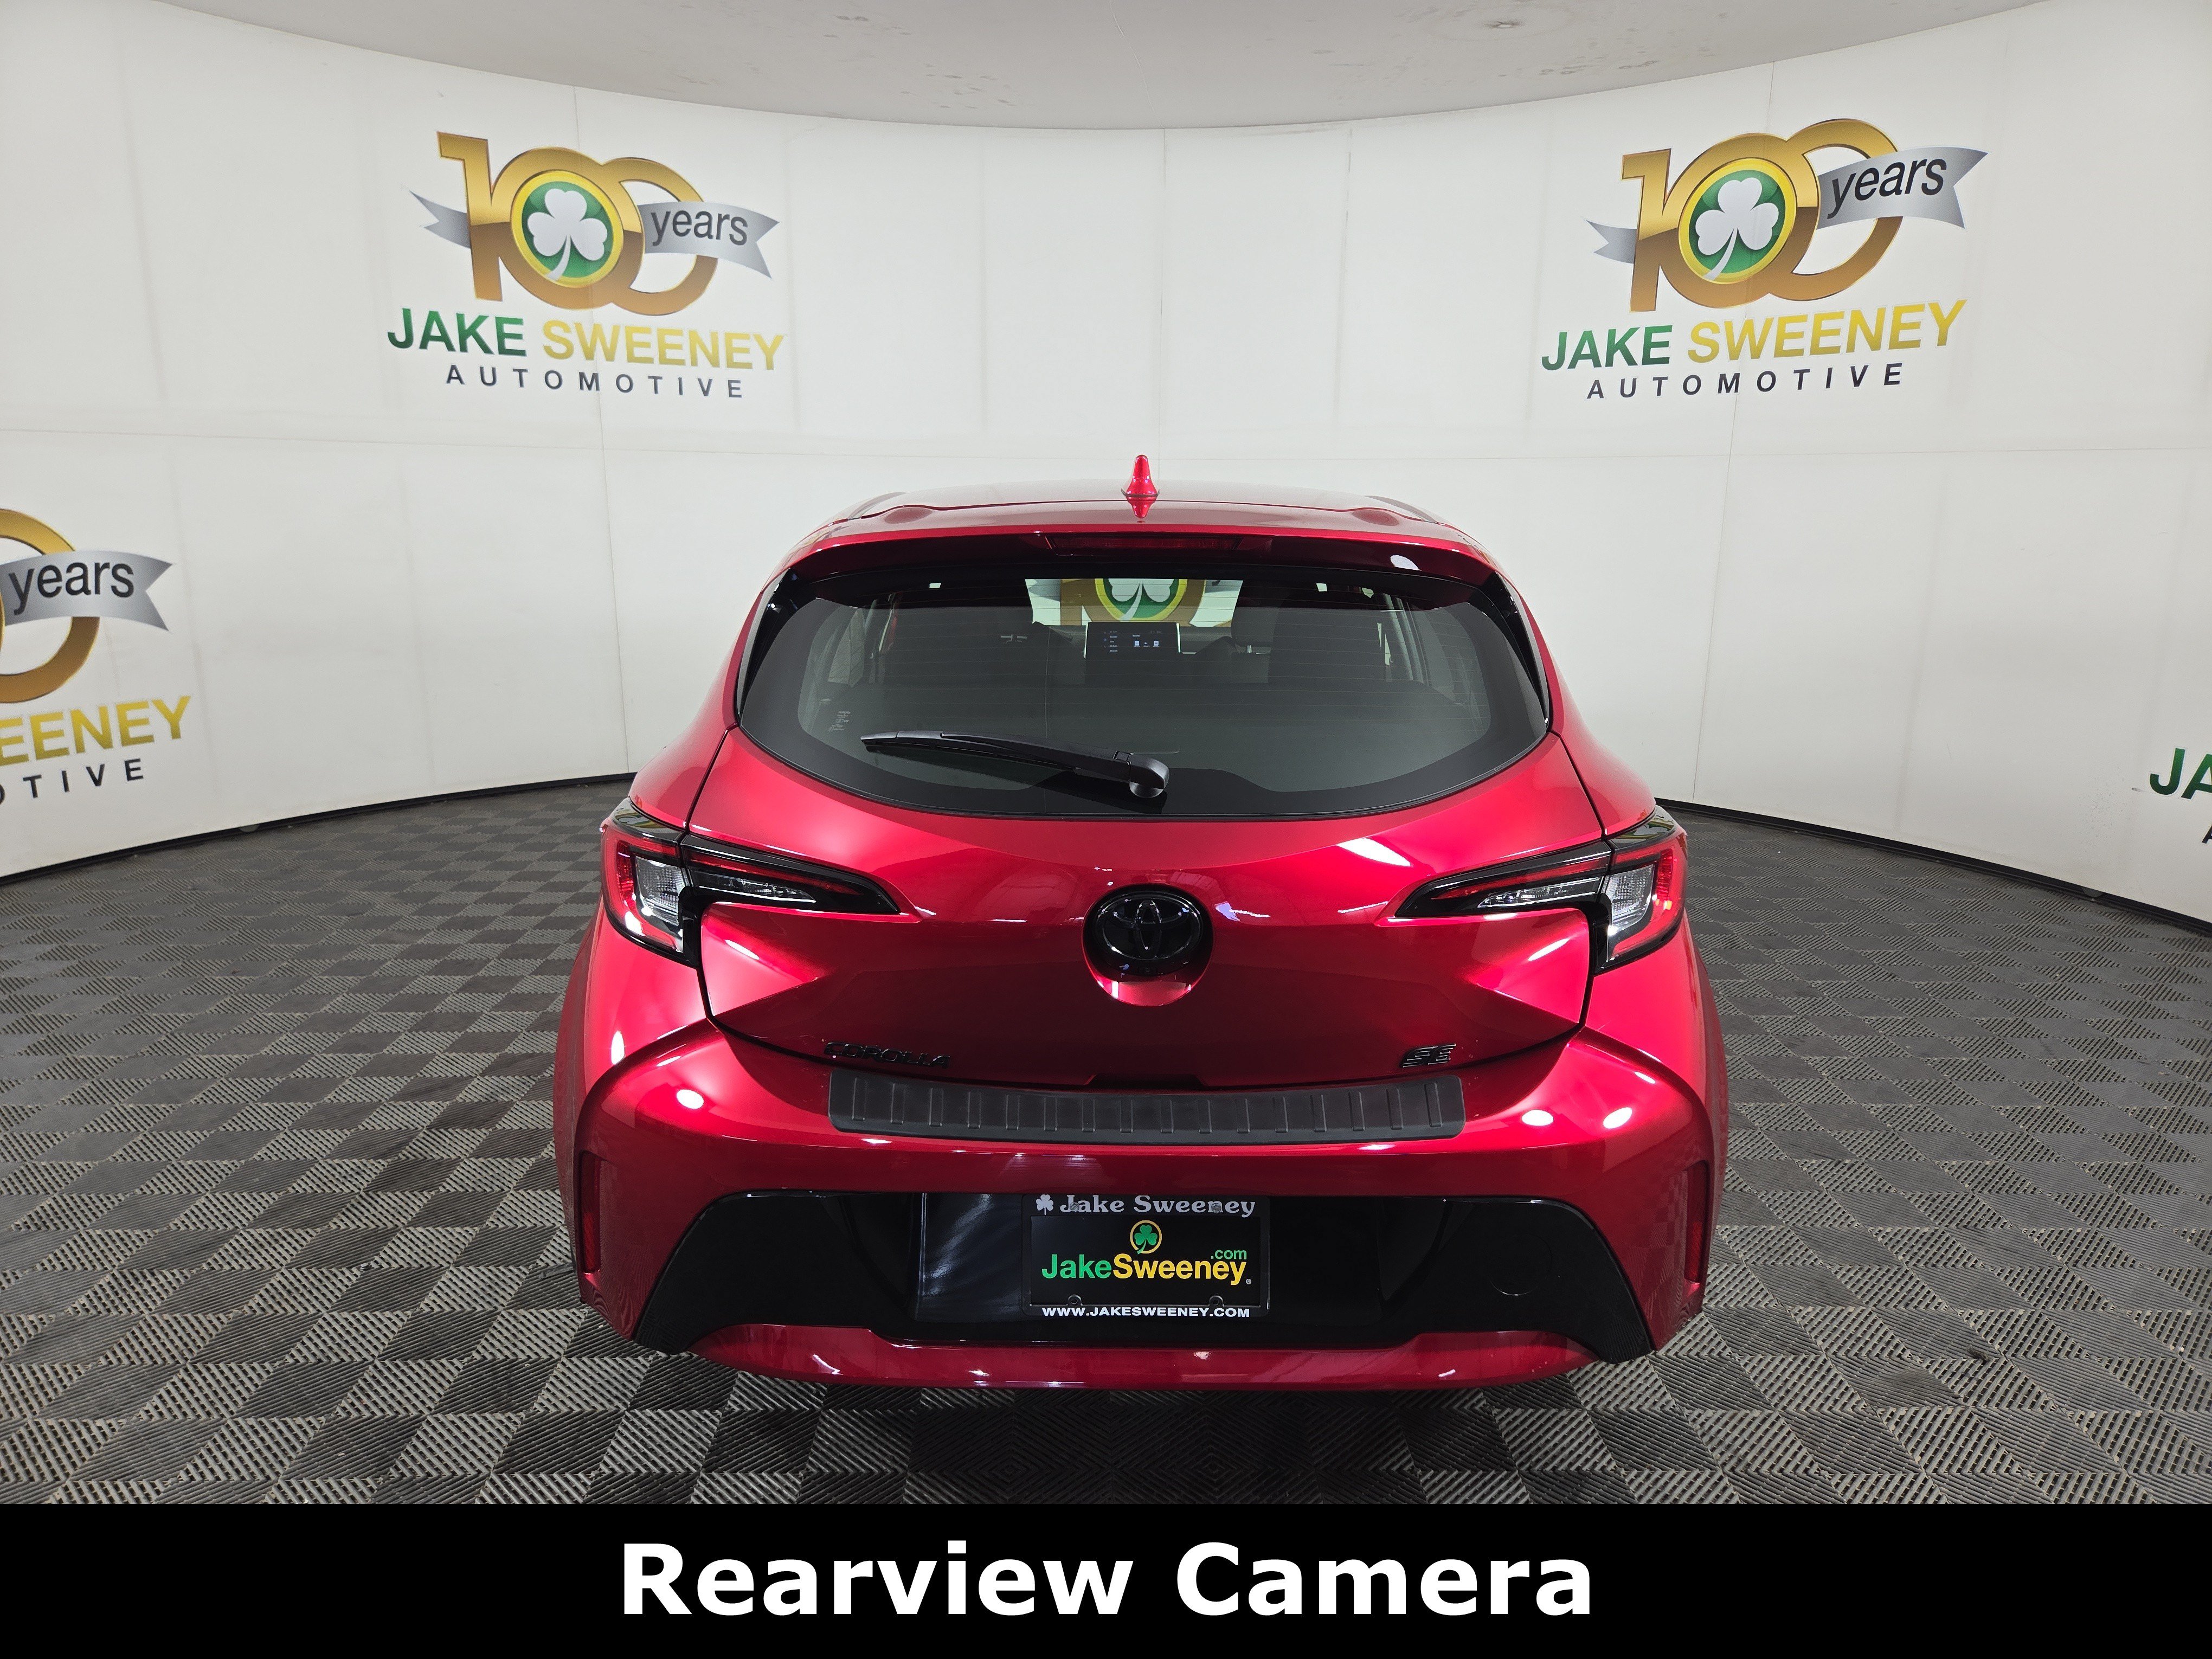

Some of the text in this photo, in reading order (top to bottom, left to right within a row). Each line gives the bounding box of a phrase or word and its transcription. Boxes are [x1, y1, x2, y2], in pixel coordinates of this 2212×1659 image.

[1827, 158, 1947, 219] years
[651, 211, 748, 246] years
[387, 307, 783, 370] JAKE SWEENEY
[1542, 299, 1967, 371] JAKE SWEENEY
[446, 364, 742, 398] AUTOMOTIVE
[1586, 363, 1902, 400] AUTOMOTIVE
[9, 562, 134, 615] years
[0, 758, 143, 805] TIVE
[824, 1041, 950, 1068] COROLLA
[1399, 1043, 1457, 1068] SE
[1060, 1194, 1256, 1218] Jake Sweeney
[1042, 1250, 1247, 1285] JakeSweeney .com
[1042, 1307, 1250, 1317] WWW.JAKESWEENEY.COM
